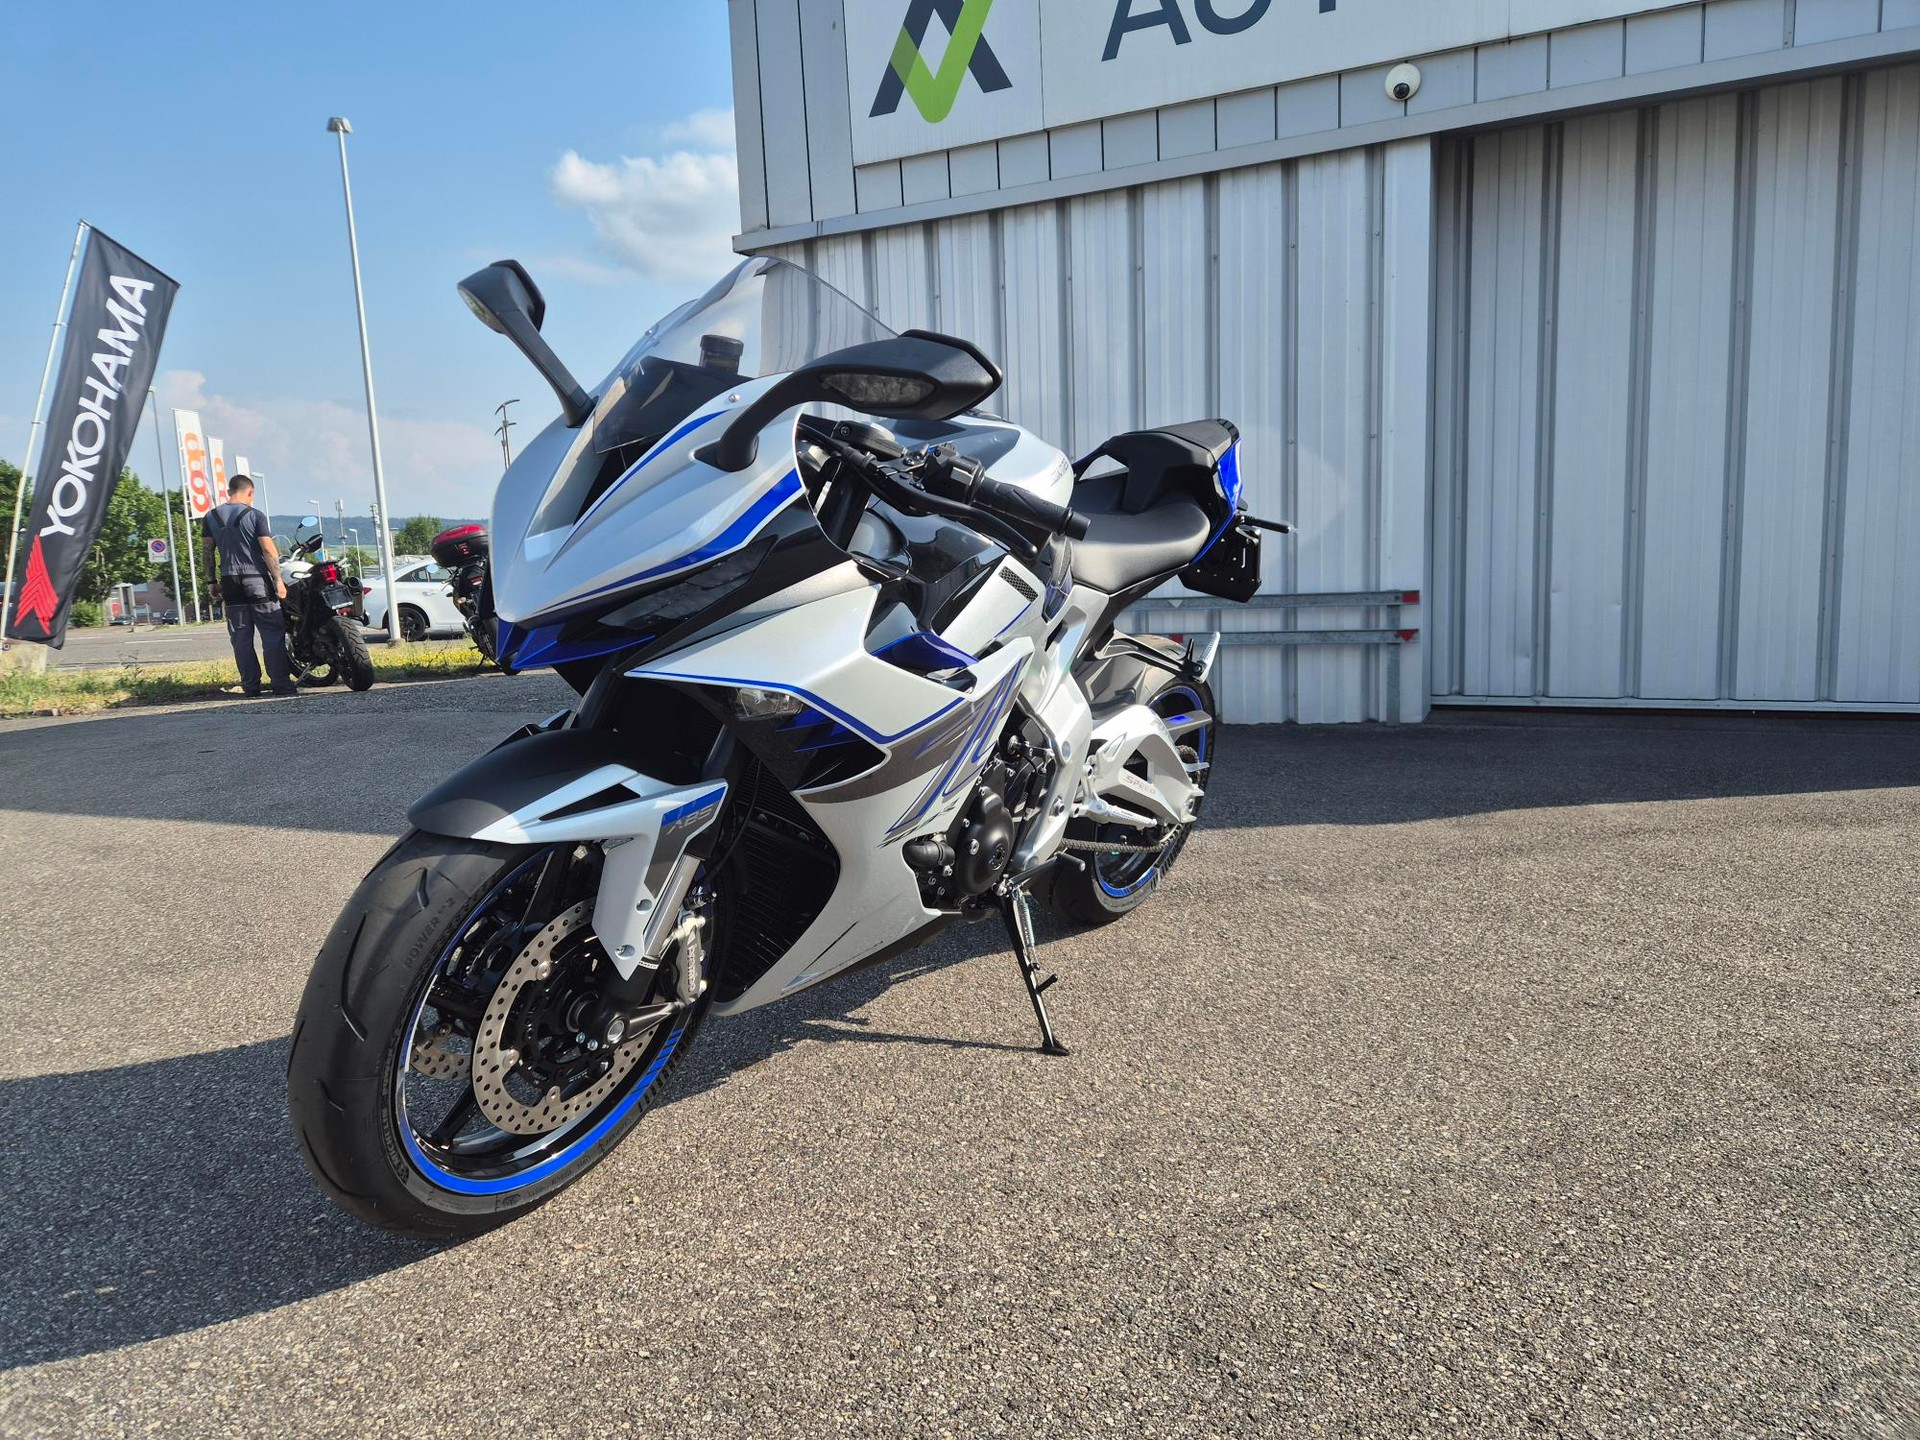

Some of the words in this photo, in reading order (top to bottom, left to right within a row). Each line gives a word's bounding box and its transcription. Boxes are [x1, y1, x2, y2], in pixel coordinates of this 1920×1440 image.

[41, 274, 155, 537] YOKOHAMA
[185, 432, 210, 512] coop
[687, 943, 697, 992] brembo
